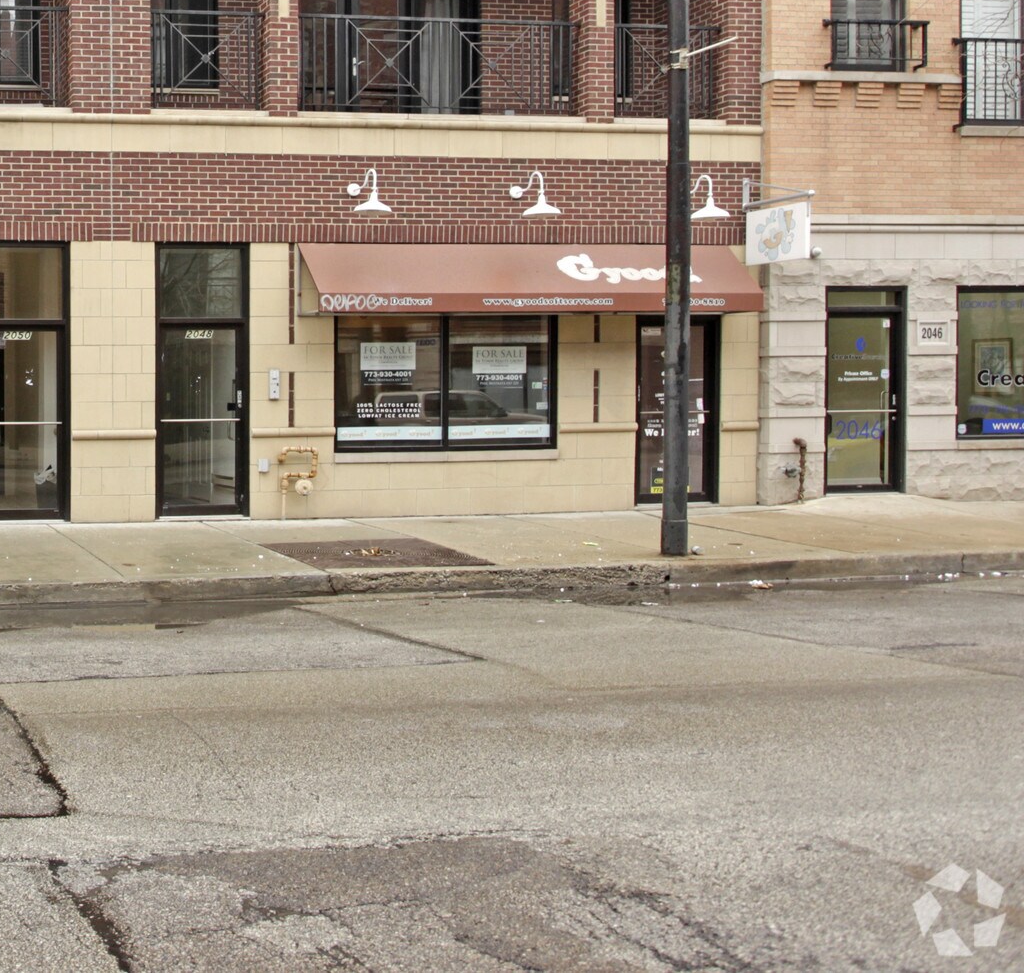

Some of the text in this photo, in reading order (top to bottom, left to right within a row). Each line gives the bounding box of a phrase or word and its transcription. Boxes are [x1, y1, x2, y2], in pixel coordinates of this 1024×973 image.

[390, 296, 434, 306] Deliver!
[483, 296, 614, 307] www.gyoodsoftserve.com
[4, 330, 31, 340] 2050
[185, 329, 214, 339] 2048
[921, 327, 943, 339] 2046
[364, 345, 413, 355] FOR SALE
[476, 349, 525, 358] FOR SALE
[644, 428, 659, 437] We
[836, 419, 883, 440] 2046
